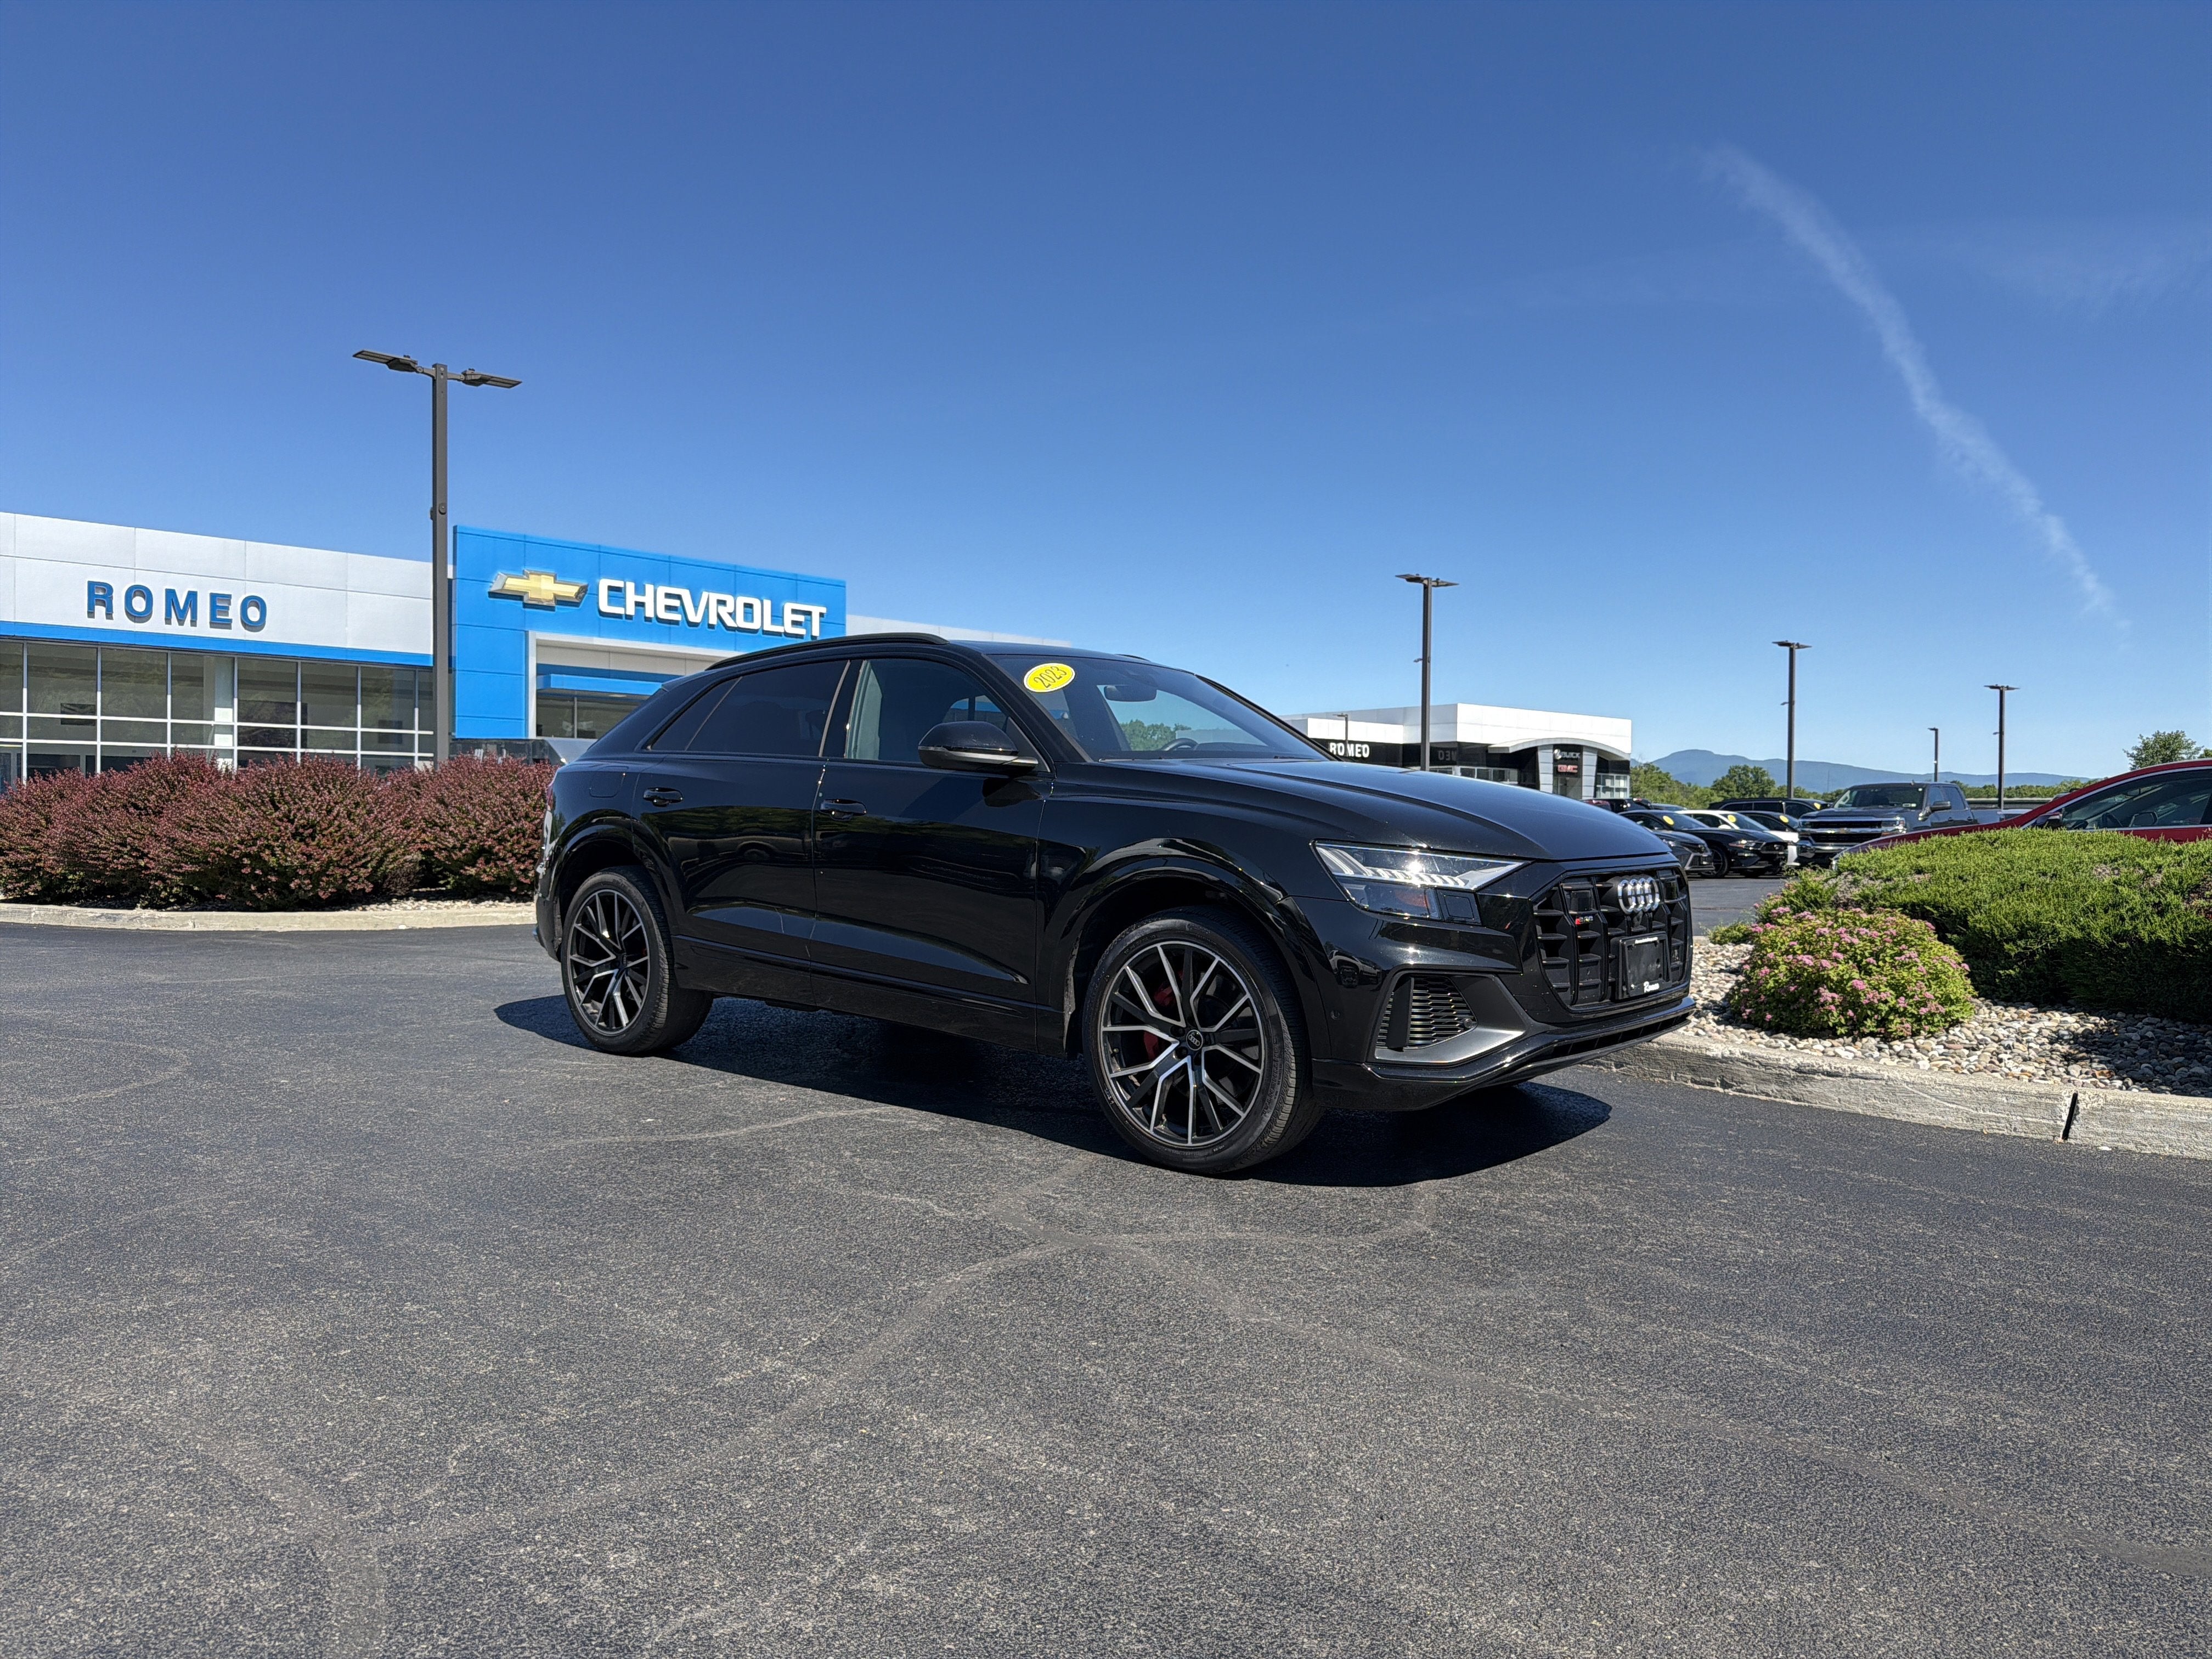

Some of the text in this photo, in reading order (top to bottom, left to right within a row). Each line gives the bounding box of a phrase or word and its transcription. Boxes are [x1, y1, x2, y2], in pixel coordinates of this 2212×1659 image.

[87, 580, 267, 629] ROMEO
[599, 578, 827, 637] CHEVROLET
[1034, 666, 1066, 688] 2023
[1329, 742, 1370, 758] ROMEO
